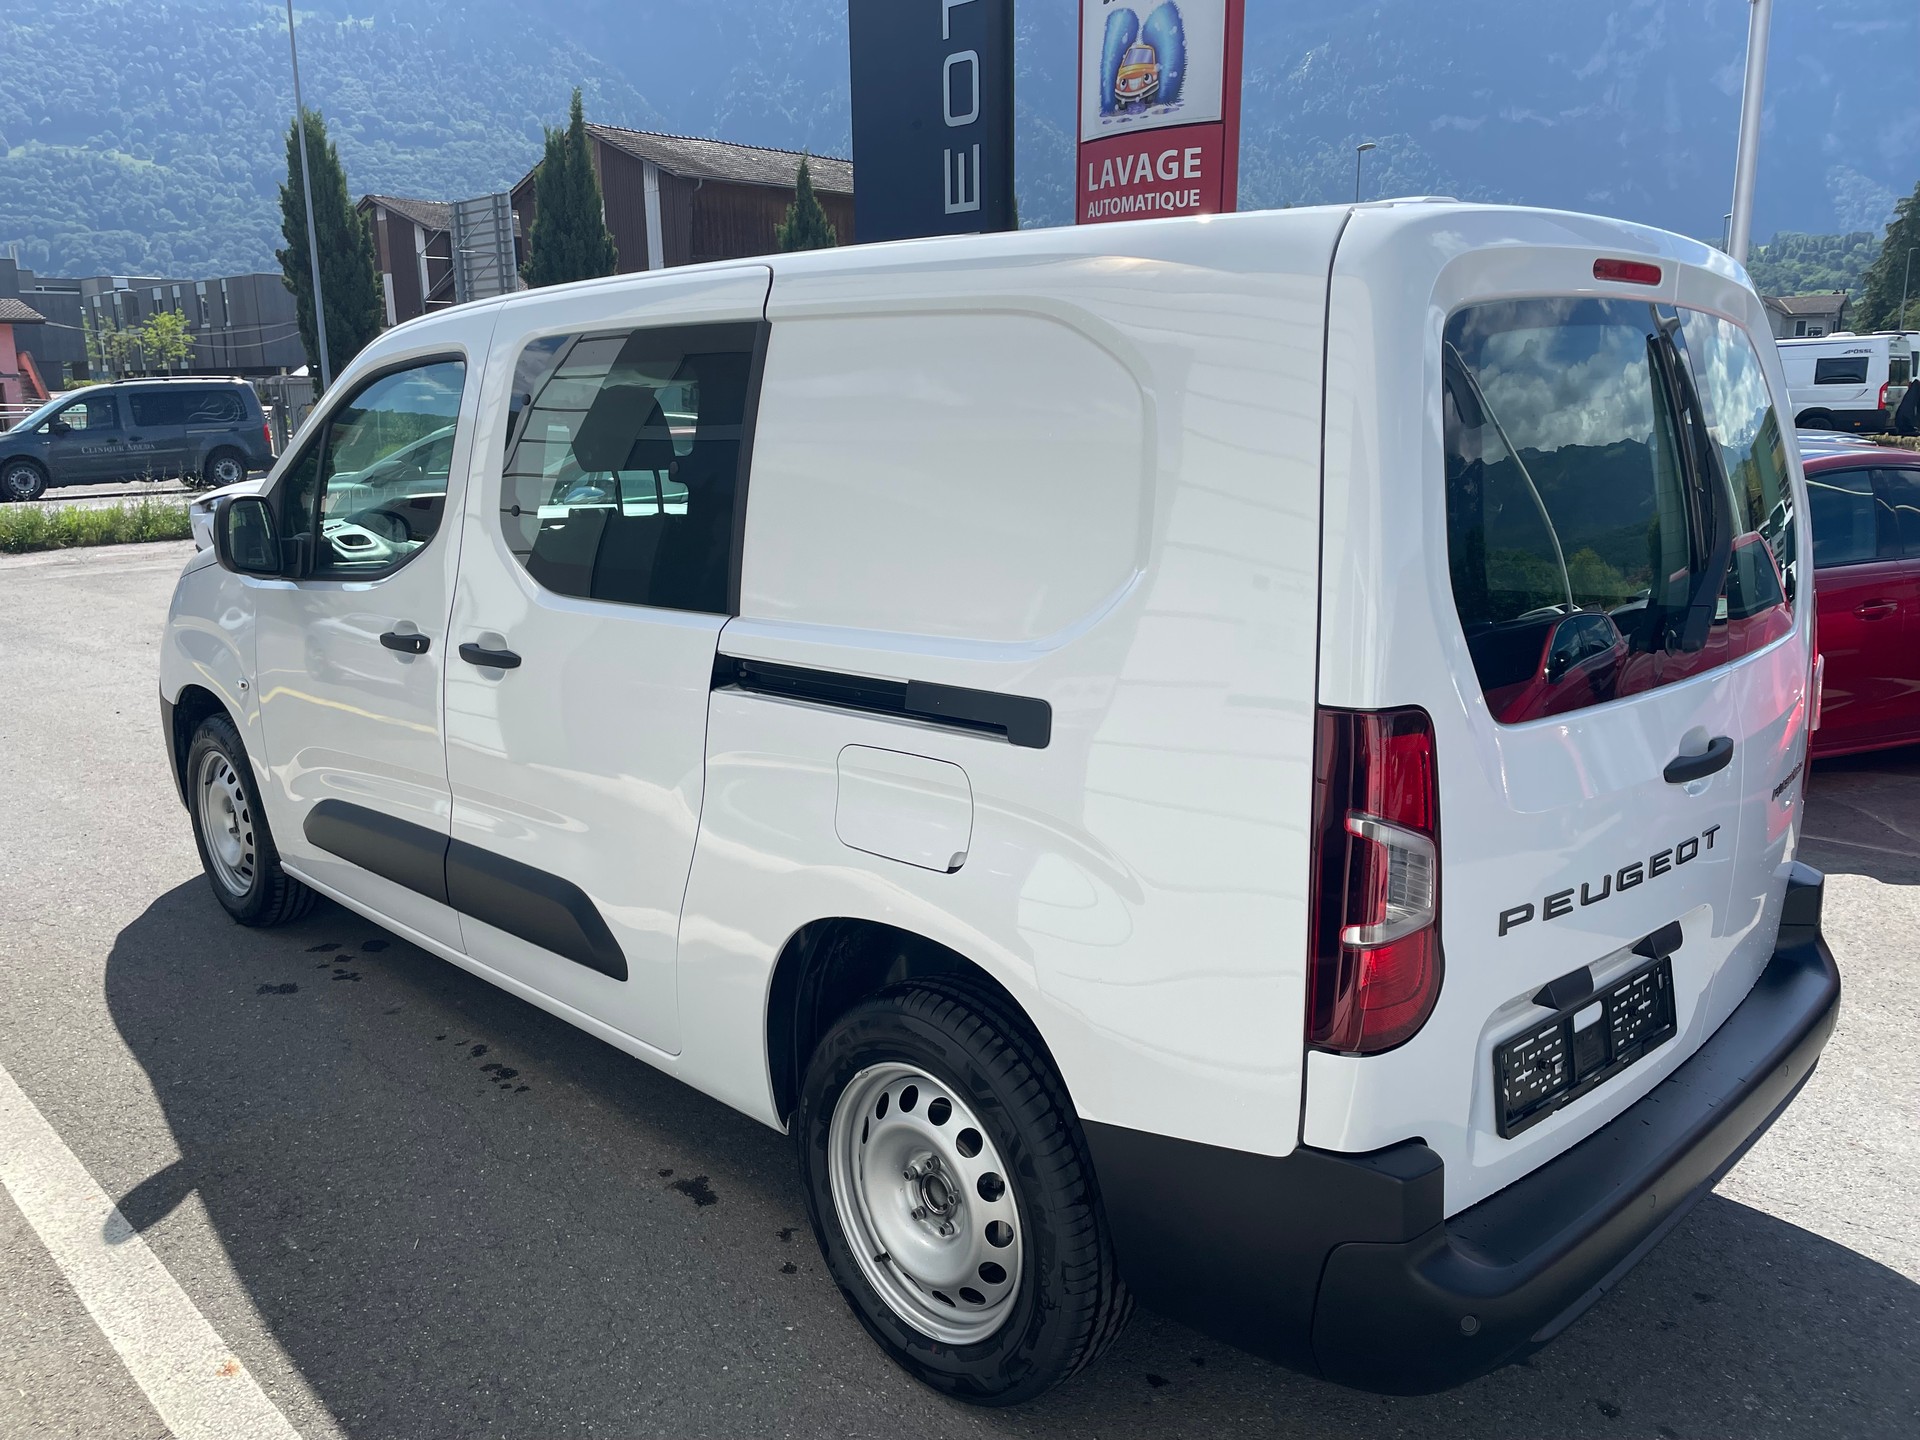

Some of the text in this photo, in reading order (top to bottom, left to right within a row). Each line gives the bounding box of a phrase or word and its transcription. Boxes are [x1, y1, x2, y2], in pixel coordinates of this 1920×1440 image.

[1088, 147, 1202, 192] LAVAGE
[1087, 189, 1200, 218] AUTOMATIQUE
[1498, 824, 1721, 938] PEUGEOT
